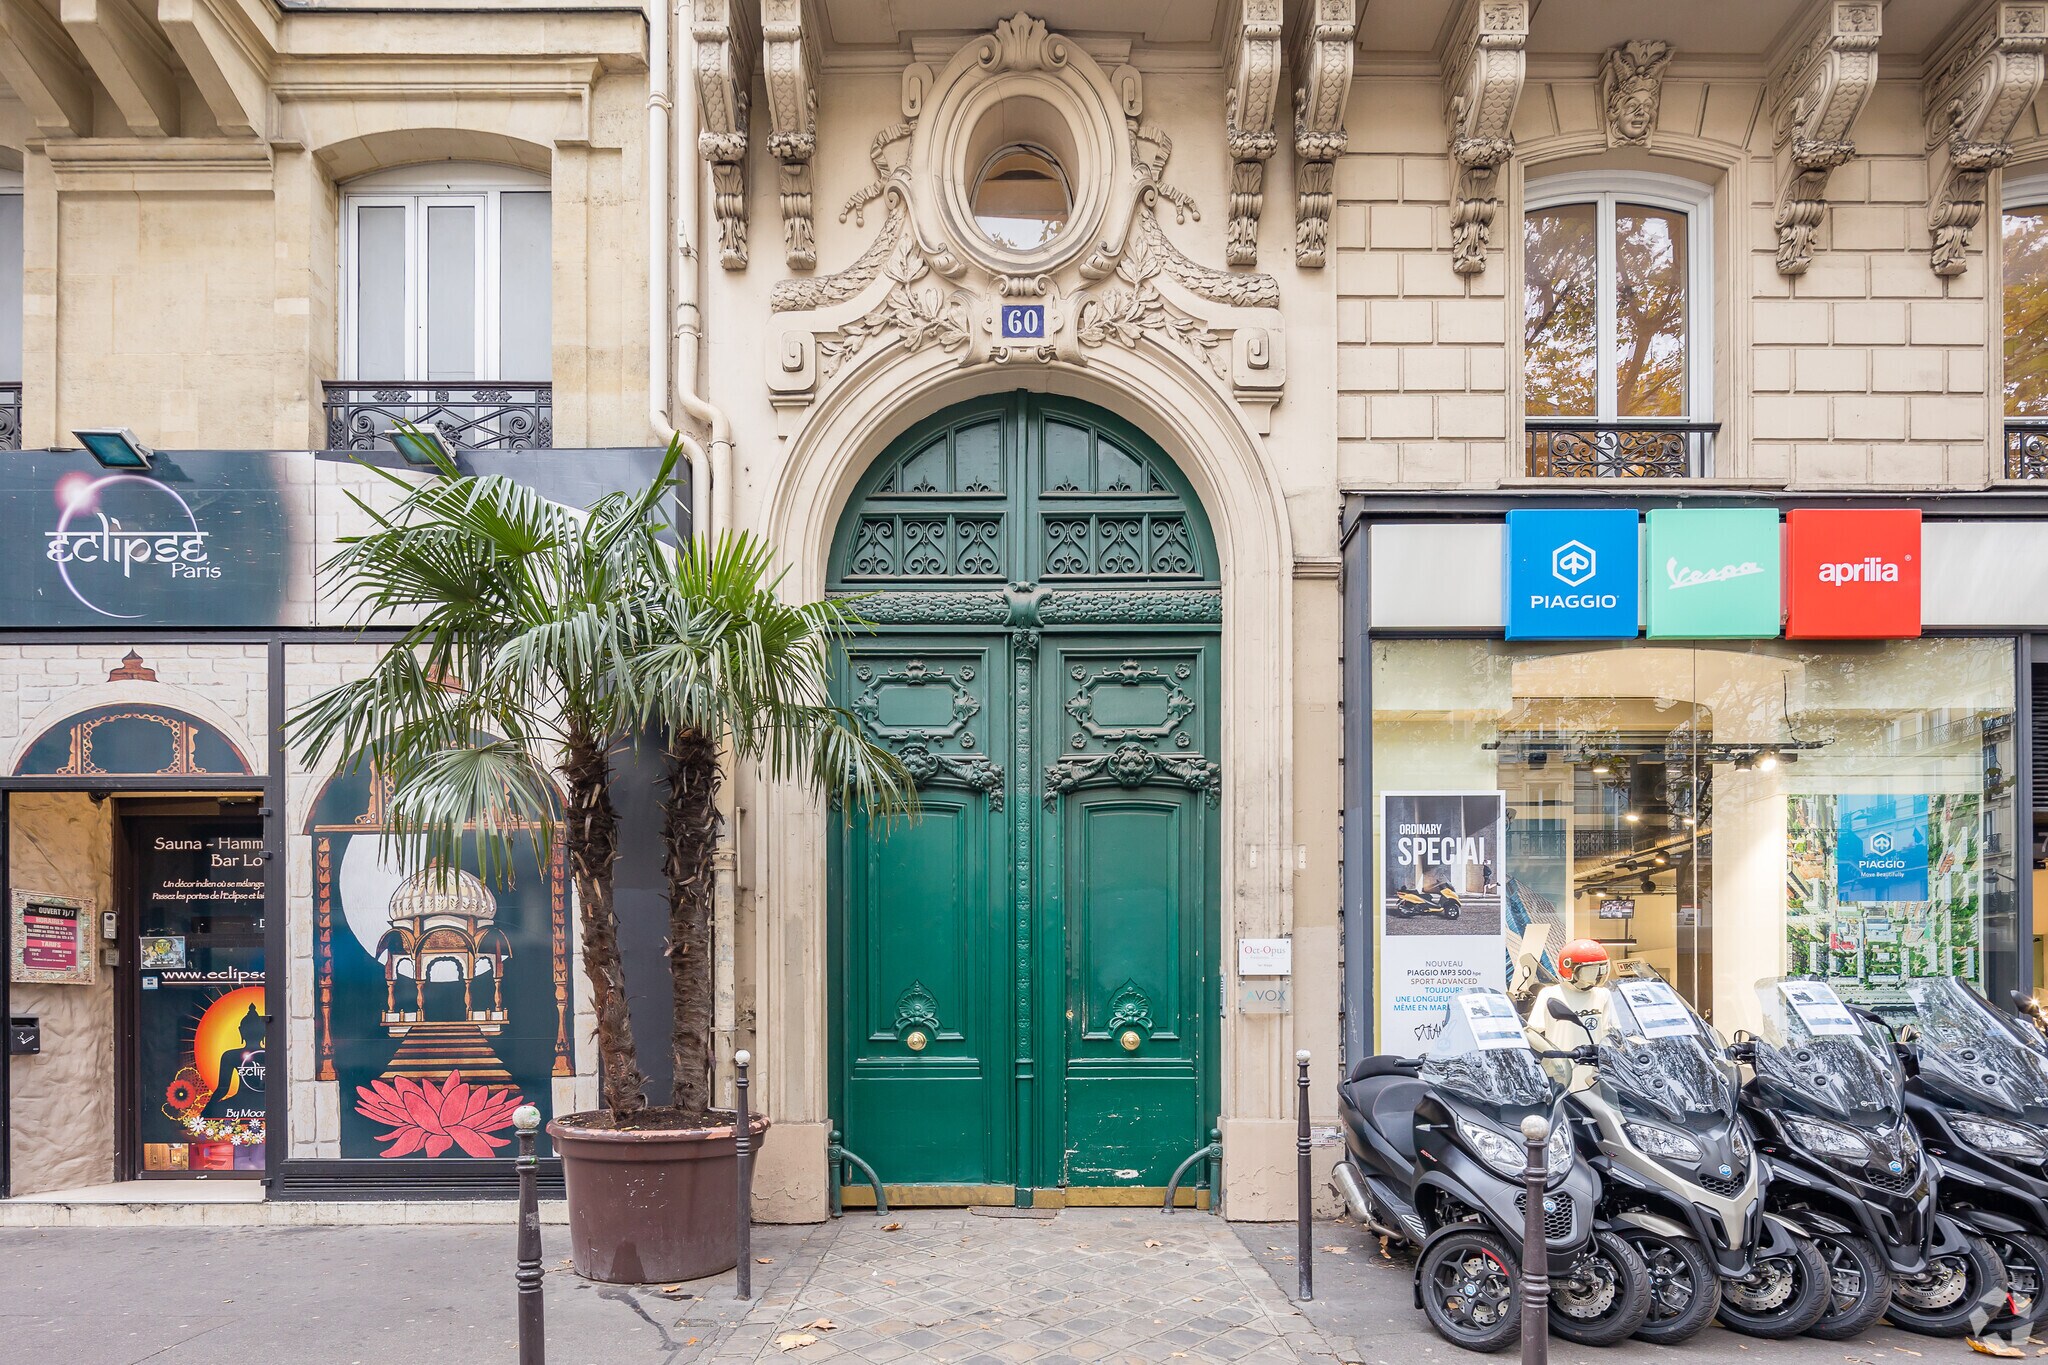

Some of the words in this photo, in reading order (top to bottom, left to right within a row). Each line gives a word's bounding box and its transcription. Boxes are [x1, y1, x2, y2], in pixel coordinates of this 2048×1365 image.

[1008, 310, 1038, 333] 60
[171, 561, 222, 578] Paris
[1666, 556, 1764, 590] Vespa
[1819, 557, 1899, 586] aprilia
[1530, 594, 1617, 608] PIAGGIO
[1400, 823, 1442, 834] ORDINARY
[154, 837, 202, 850] Sauna
[211, 854, 239, 867] Bar
[226, 1109, 240, 1121] By
